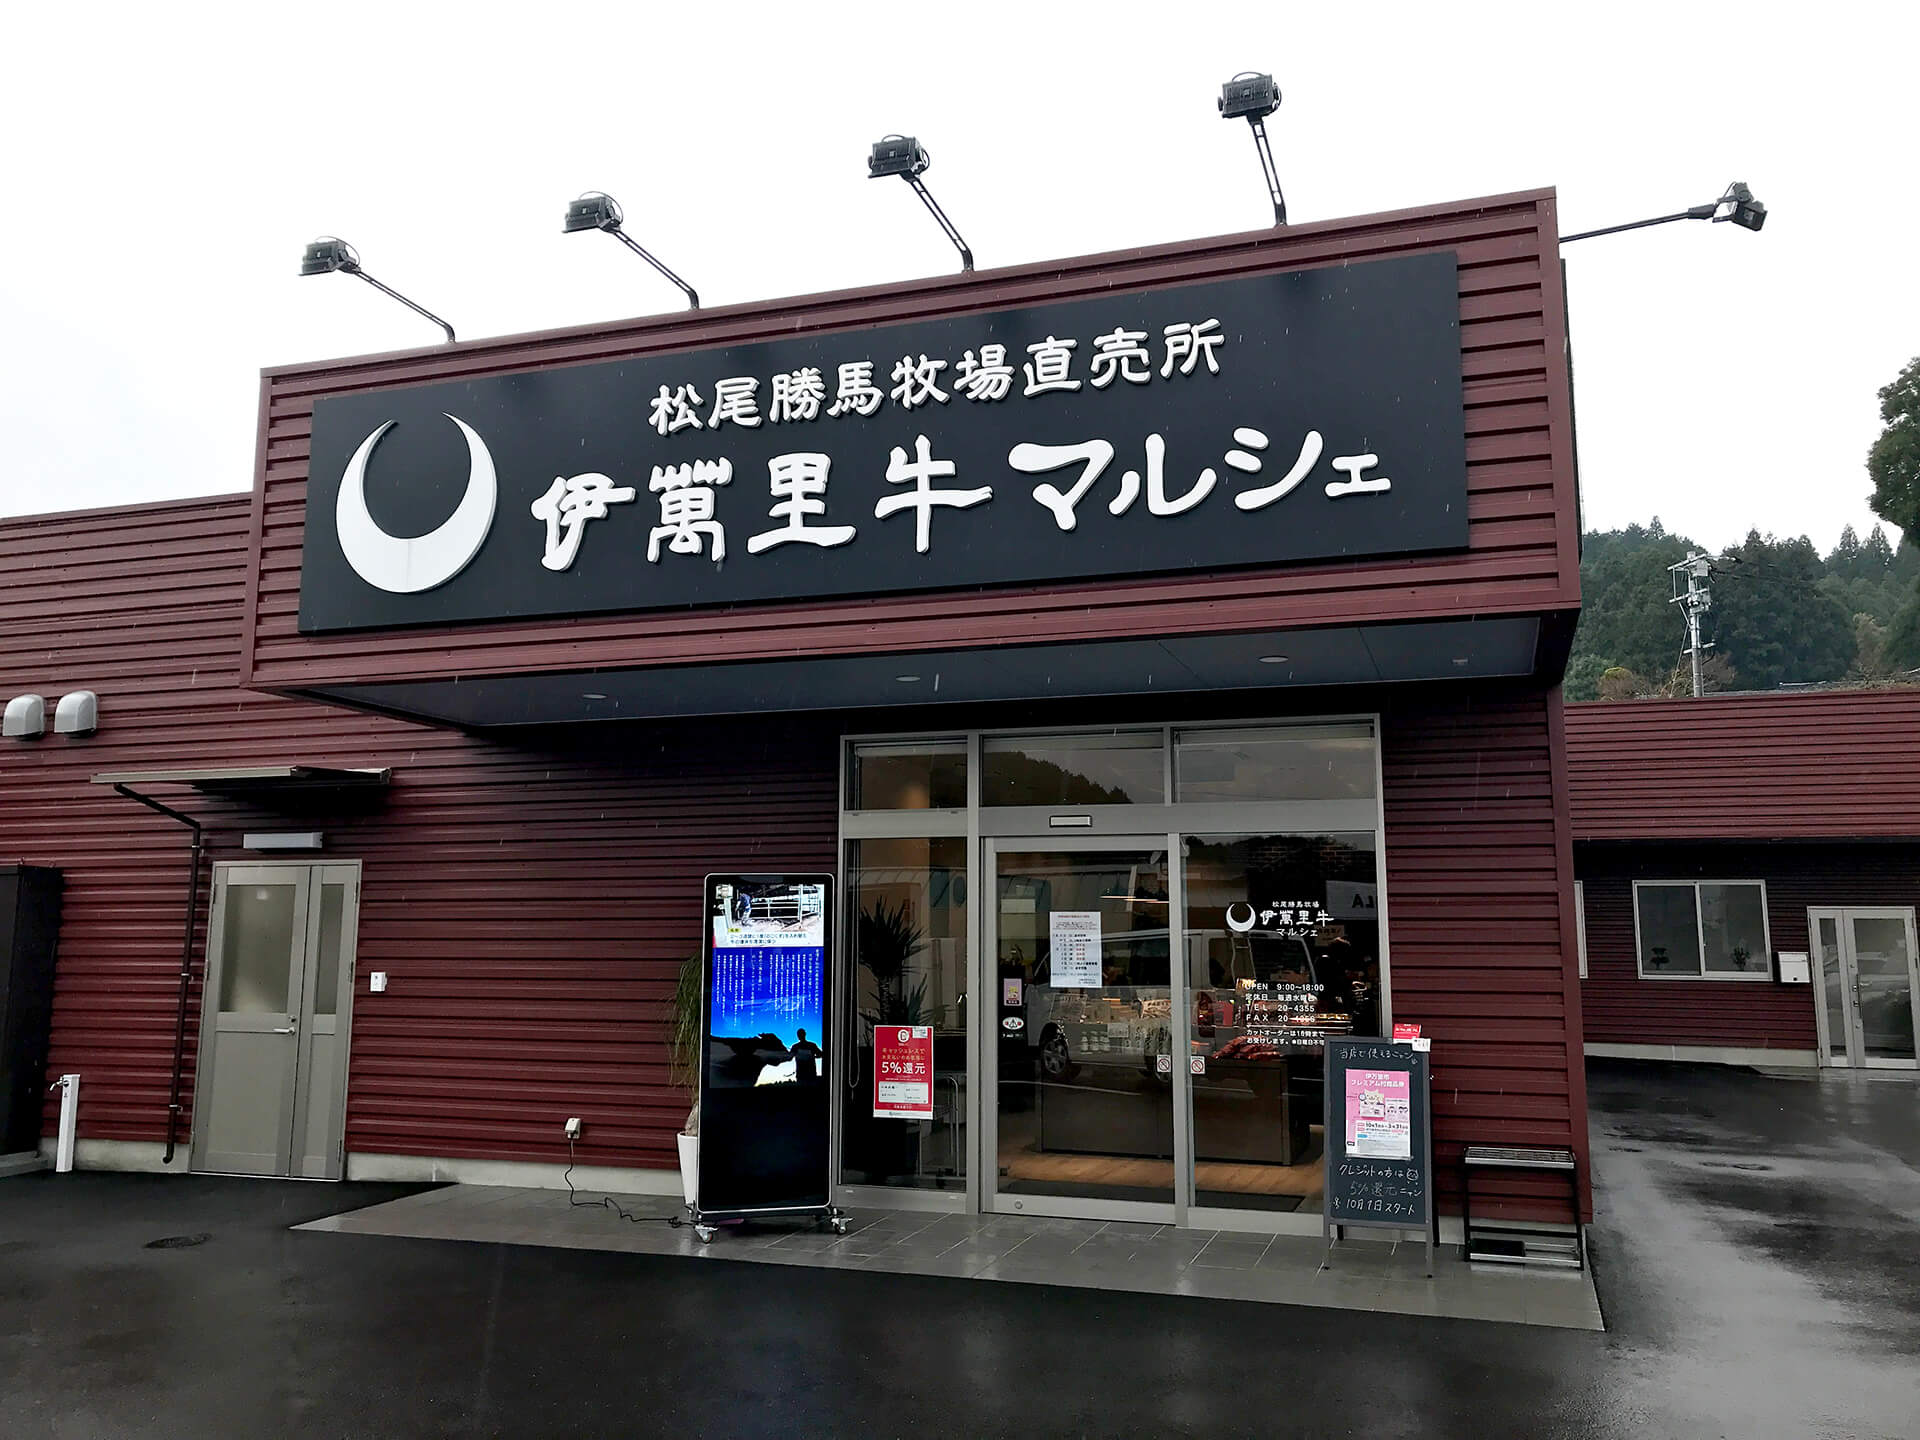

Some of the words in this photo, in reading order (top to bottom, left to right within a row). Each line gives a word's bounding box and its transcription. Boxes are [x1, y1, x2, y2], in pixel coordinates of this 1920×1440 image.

[649, 319, 1224, 434] 松尾勝馬牧場直売所
[531, 428, 1391, 570] 伊萬里牛マルシェ
[1272, 900, 1320, 908] 松尾勝馬牧場
[1259, 909, 1335, 928] 伊萬里牛
[1276, 927, 1319, 937] マルシェ
[1245, 993, 1269, 1001] 定休日
[1277, 1004, 1315, 1012] 20-4355
[881, 1061, 926, 1075] 5%還元
